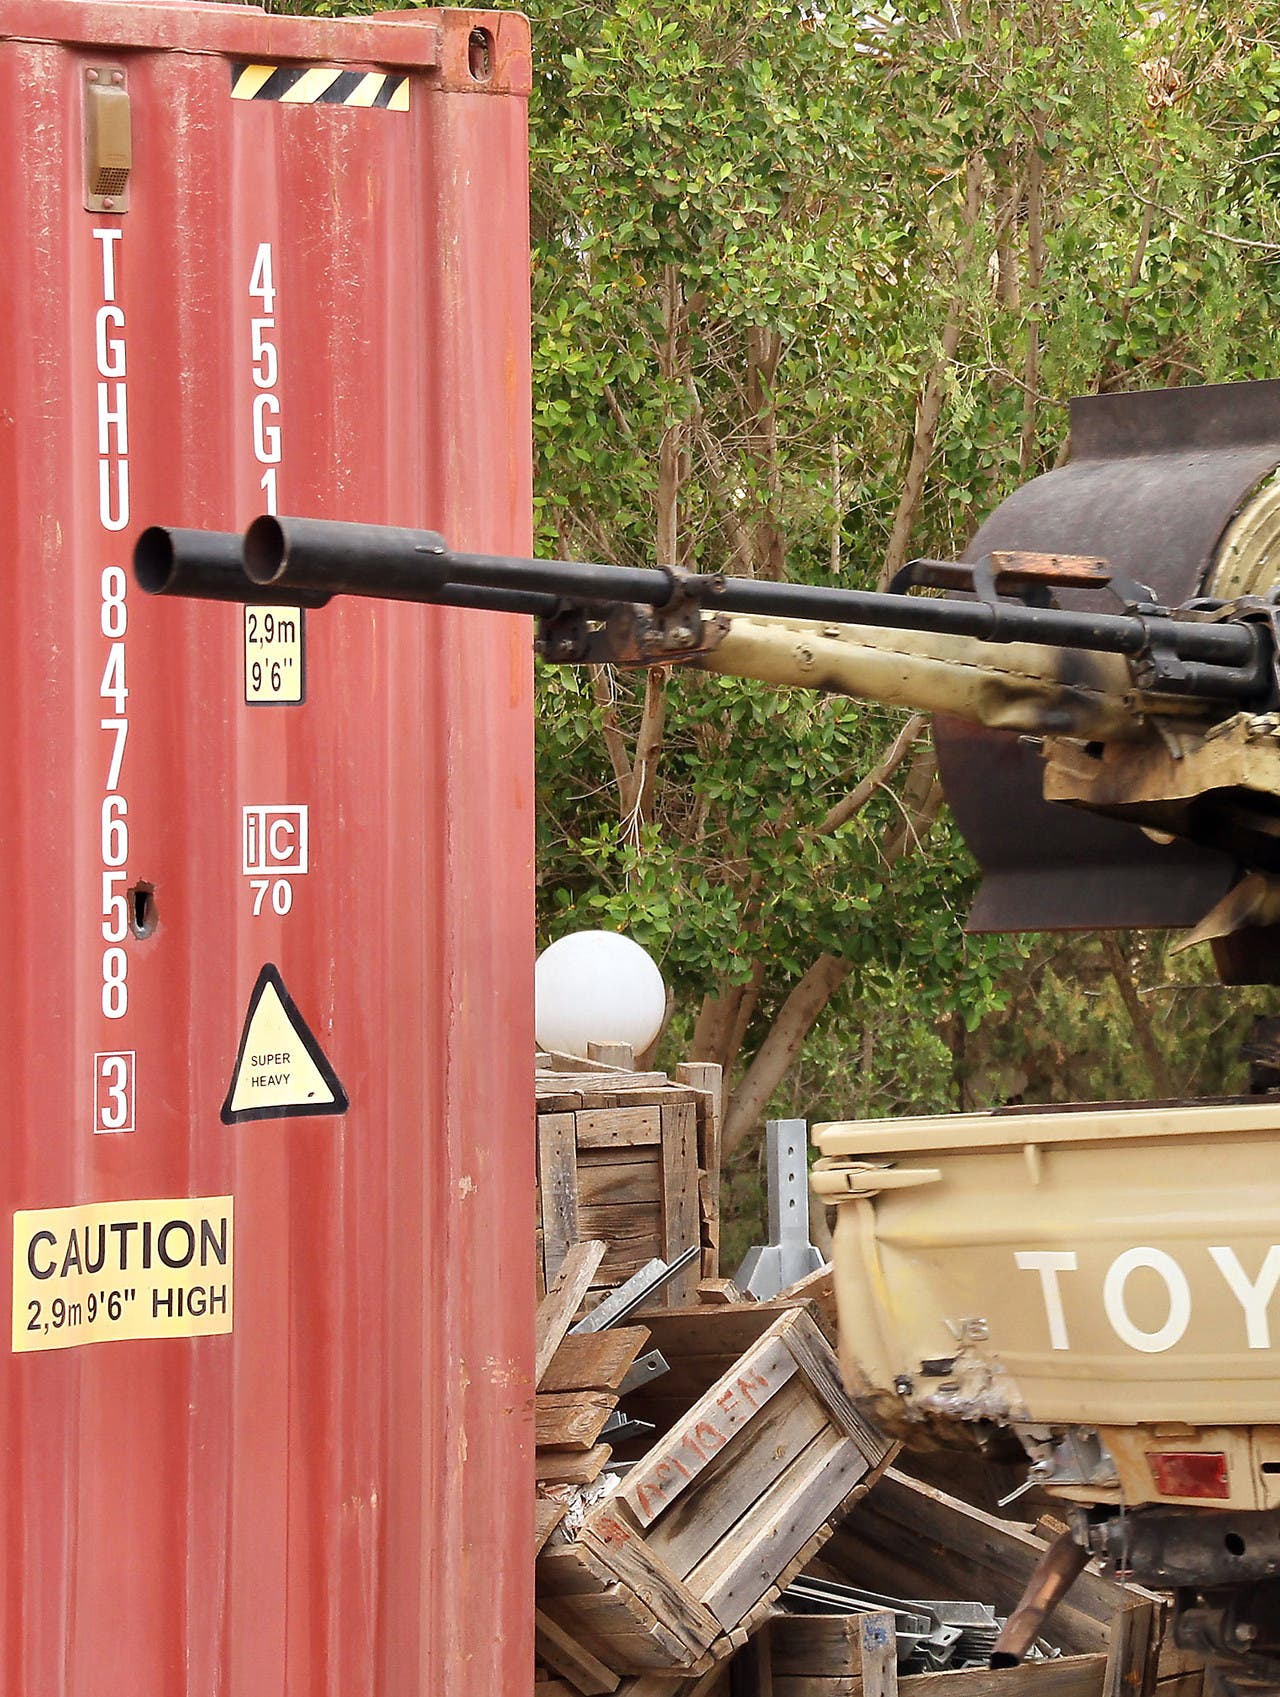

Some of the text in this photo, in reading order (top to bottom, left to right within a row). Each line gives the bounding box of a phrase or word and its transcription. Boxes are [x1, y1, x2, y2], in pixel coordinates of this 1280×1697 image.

[248, 242, 283, 517] 45G1
[248, 613, 296, 650] 2,9m
[93, 228, 130, 1128] TGHU 847658 3
[251, 657, 293, 692] 9'6"
[249, 879, 293, 916] 70
[251, 1052, 291, 1067] SUPER
[251, 1073, 291, 1088] HEAVY
[27, 1218, 228, 1280] CAUTION
[152, 1284, 228, 1318] HIGH
